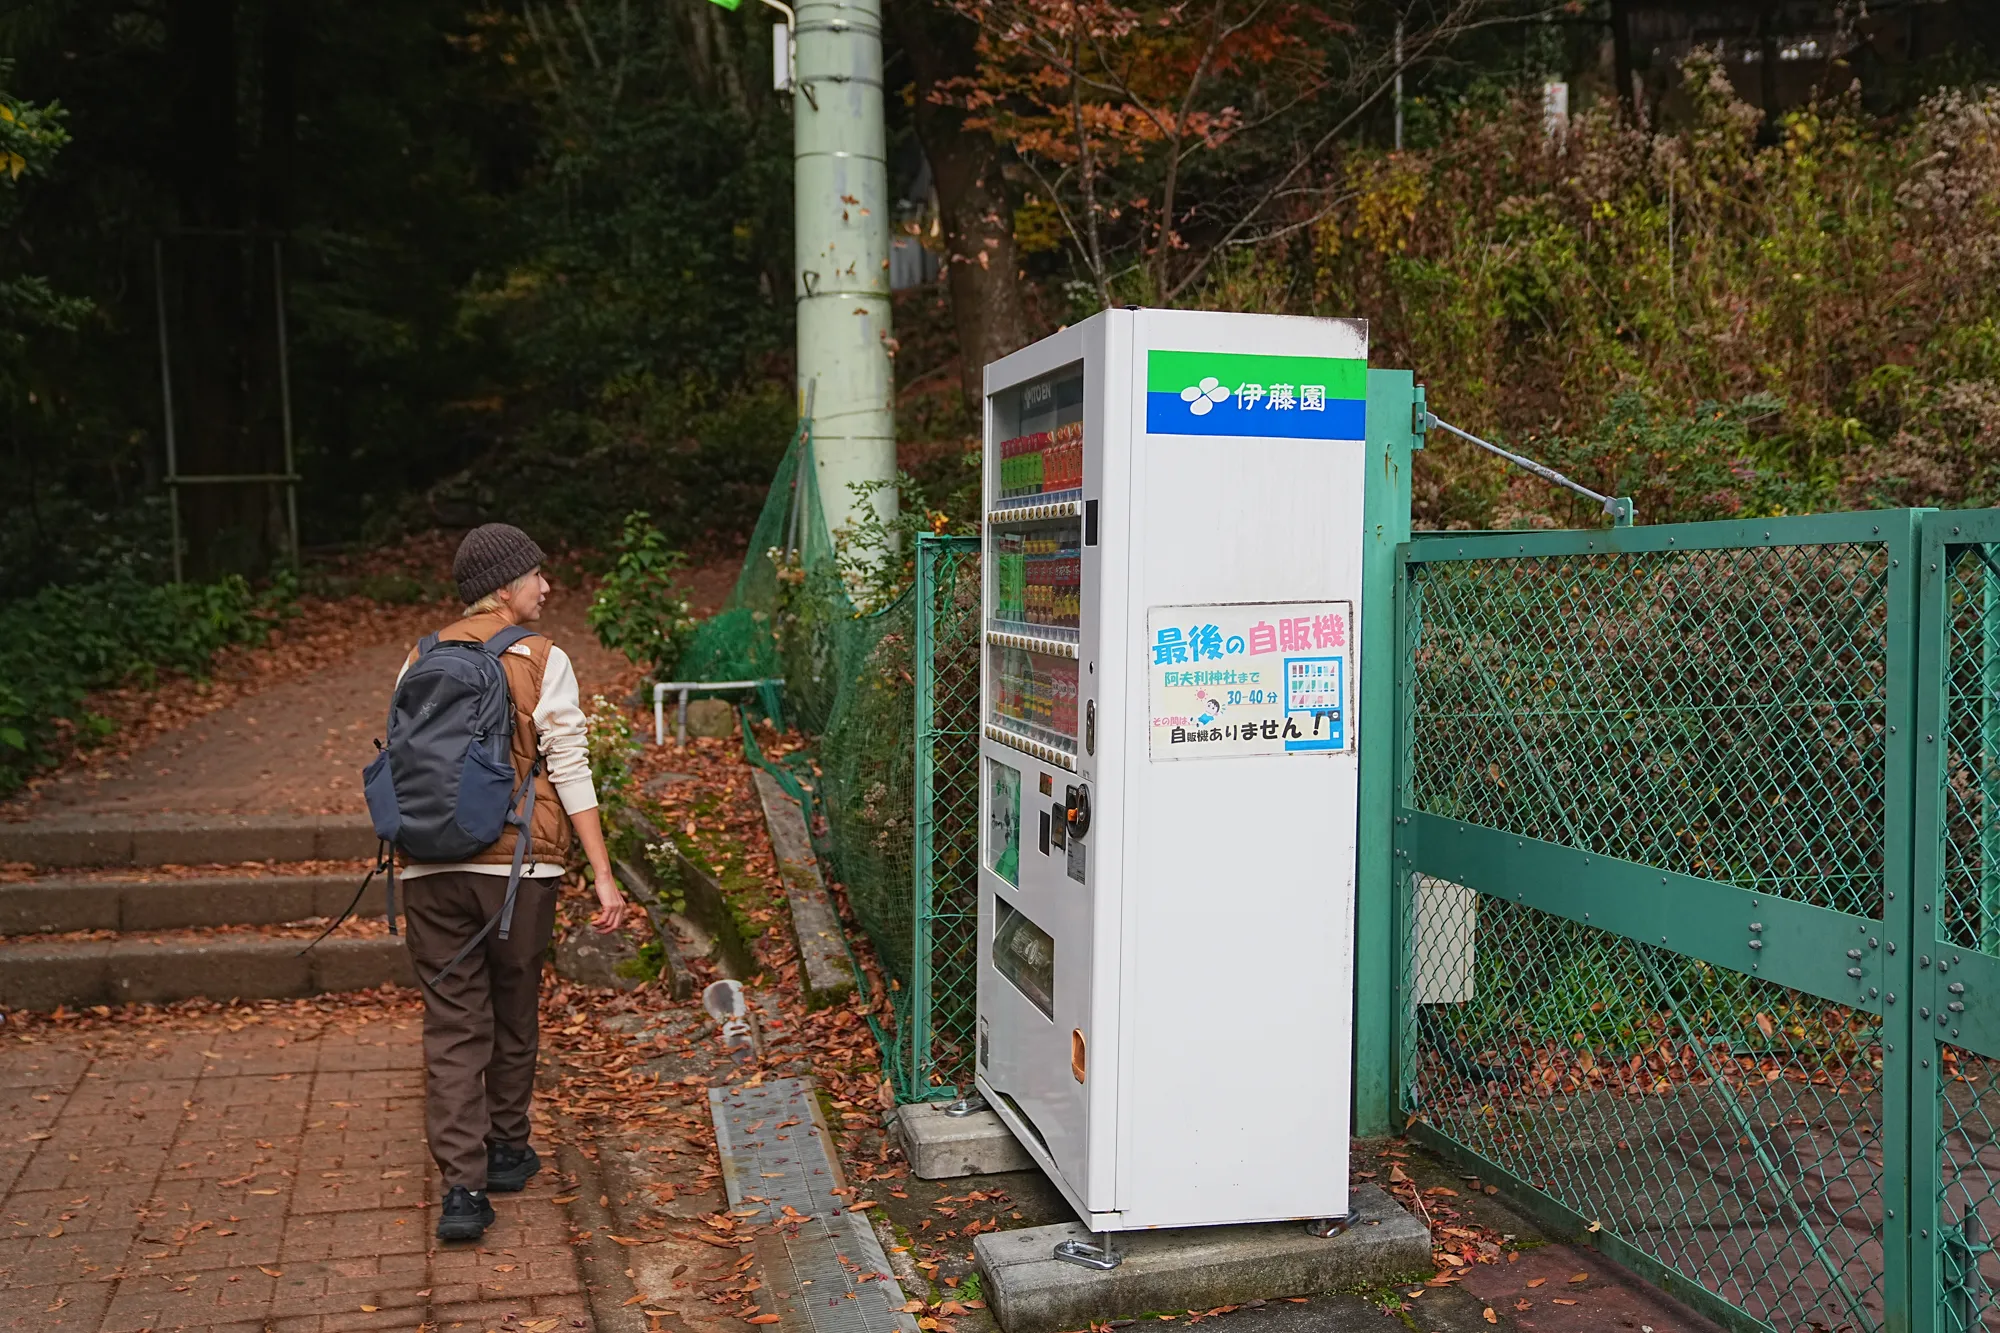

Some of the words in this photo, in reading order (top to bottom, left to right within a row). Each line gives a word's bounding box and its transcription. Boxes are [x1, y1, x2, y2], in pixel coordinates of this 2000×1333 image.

[1234, 381, 1327, 412] 伊藤園
[1152, 614, 1345, 665] 最後の自販機
[1164, 670, 1260, 686] 阿夫利神社まで
